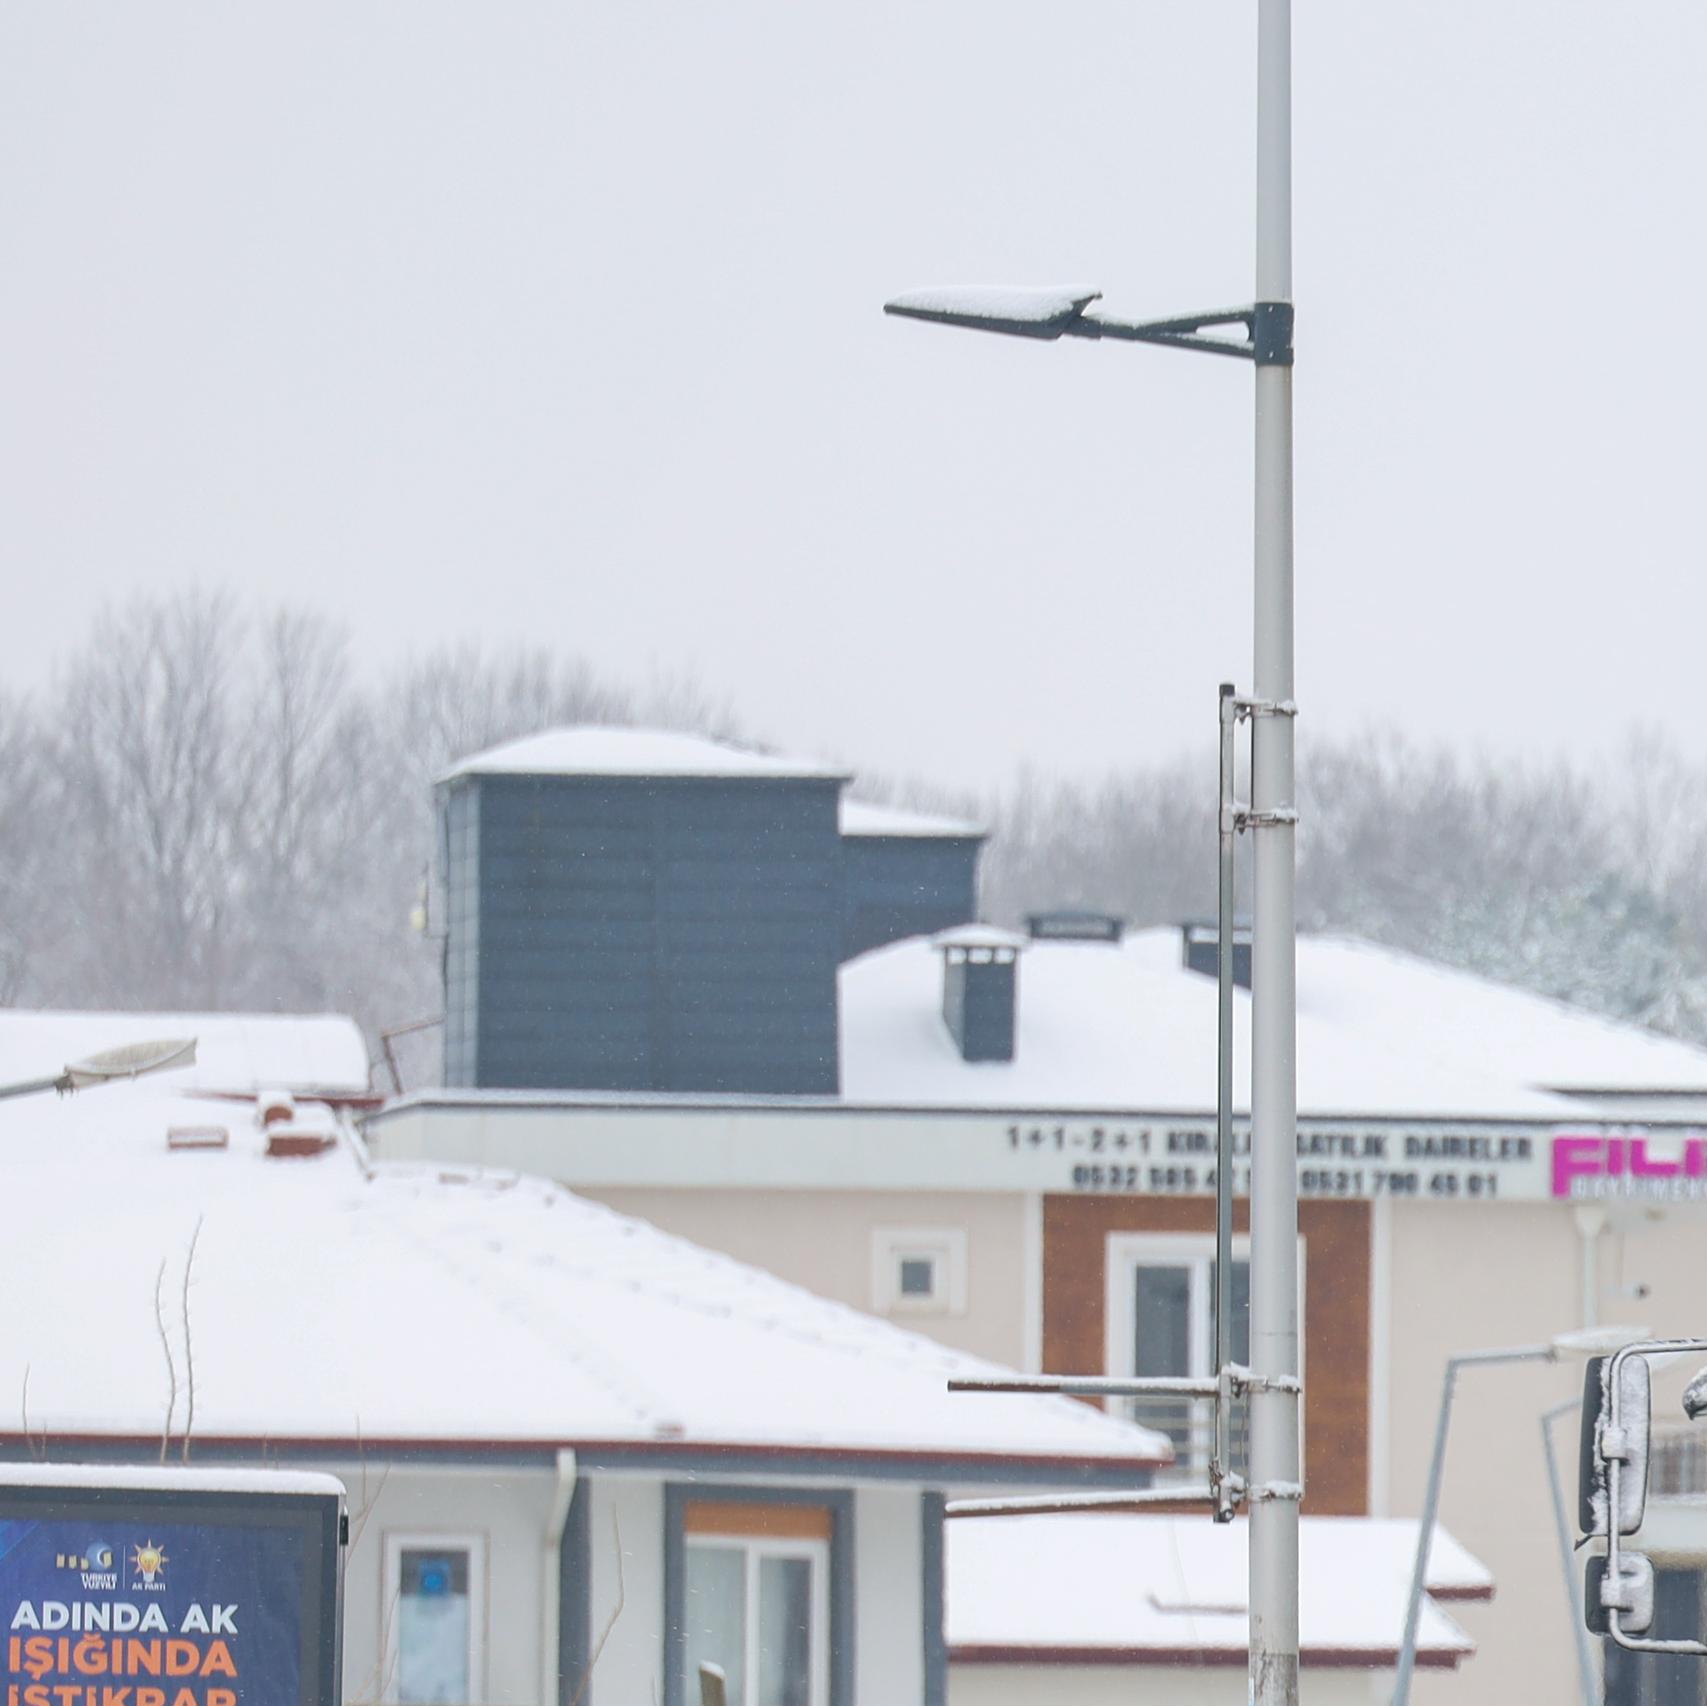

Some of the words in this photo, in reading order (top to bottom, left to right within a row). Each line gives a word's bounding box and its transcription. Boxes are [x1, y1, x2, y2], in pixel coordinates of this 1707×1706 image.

[10, 1600, 169, 1632] ADINDA
[180, 1604, 239, 1634] AK
[9, 1633, 238, 1680] IŞIĞINDA
